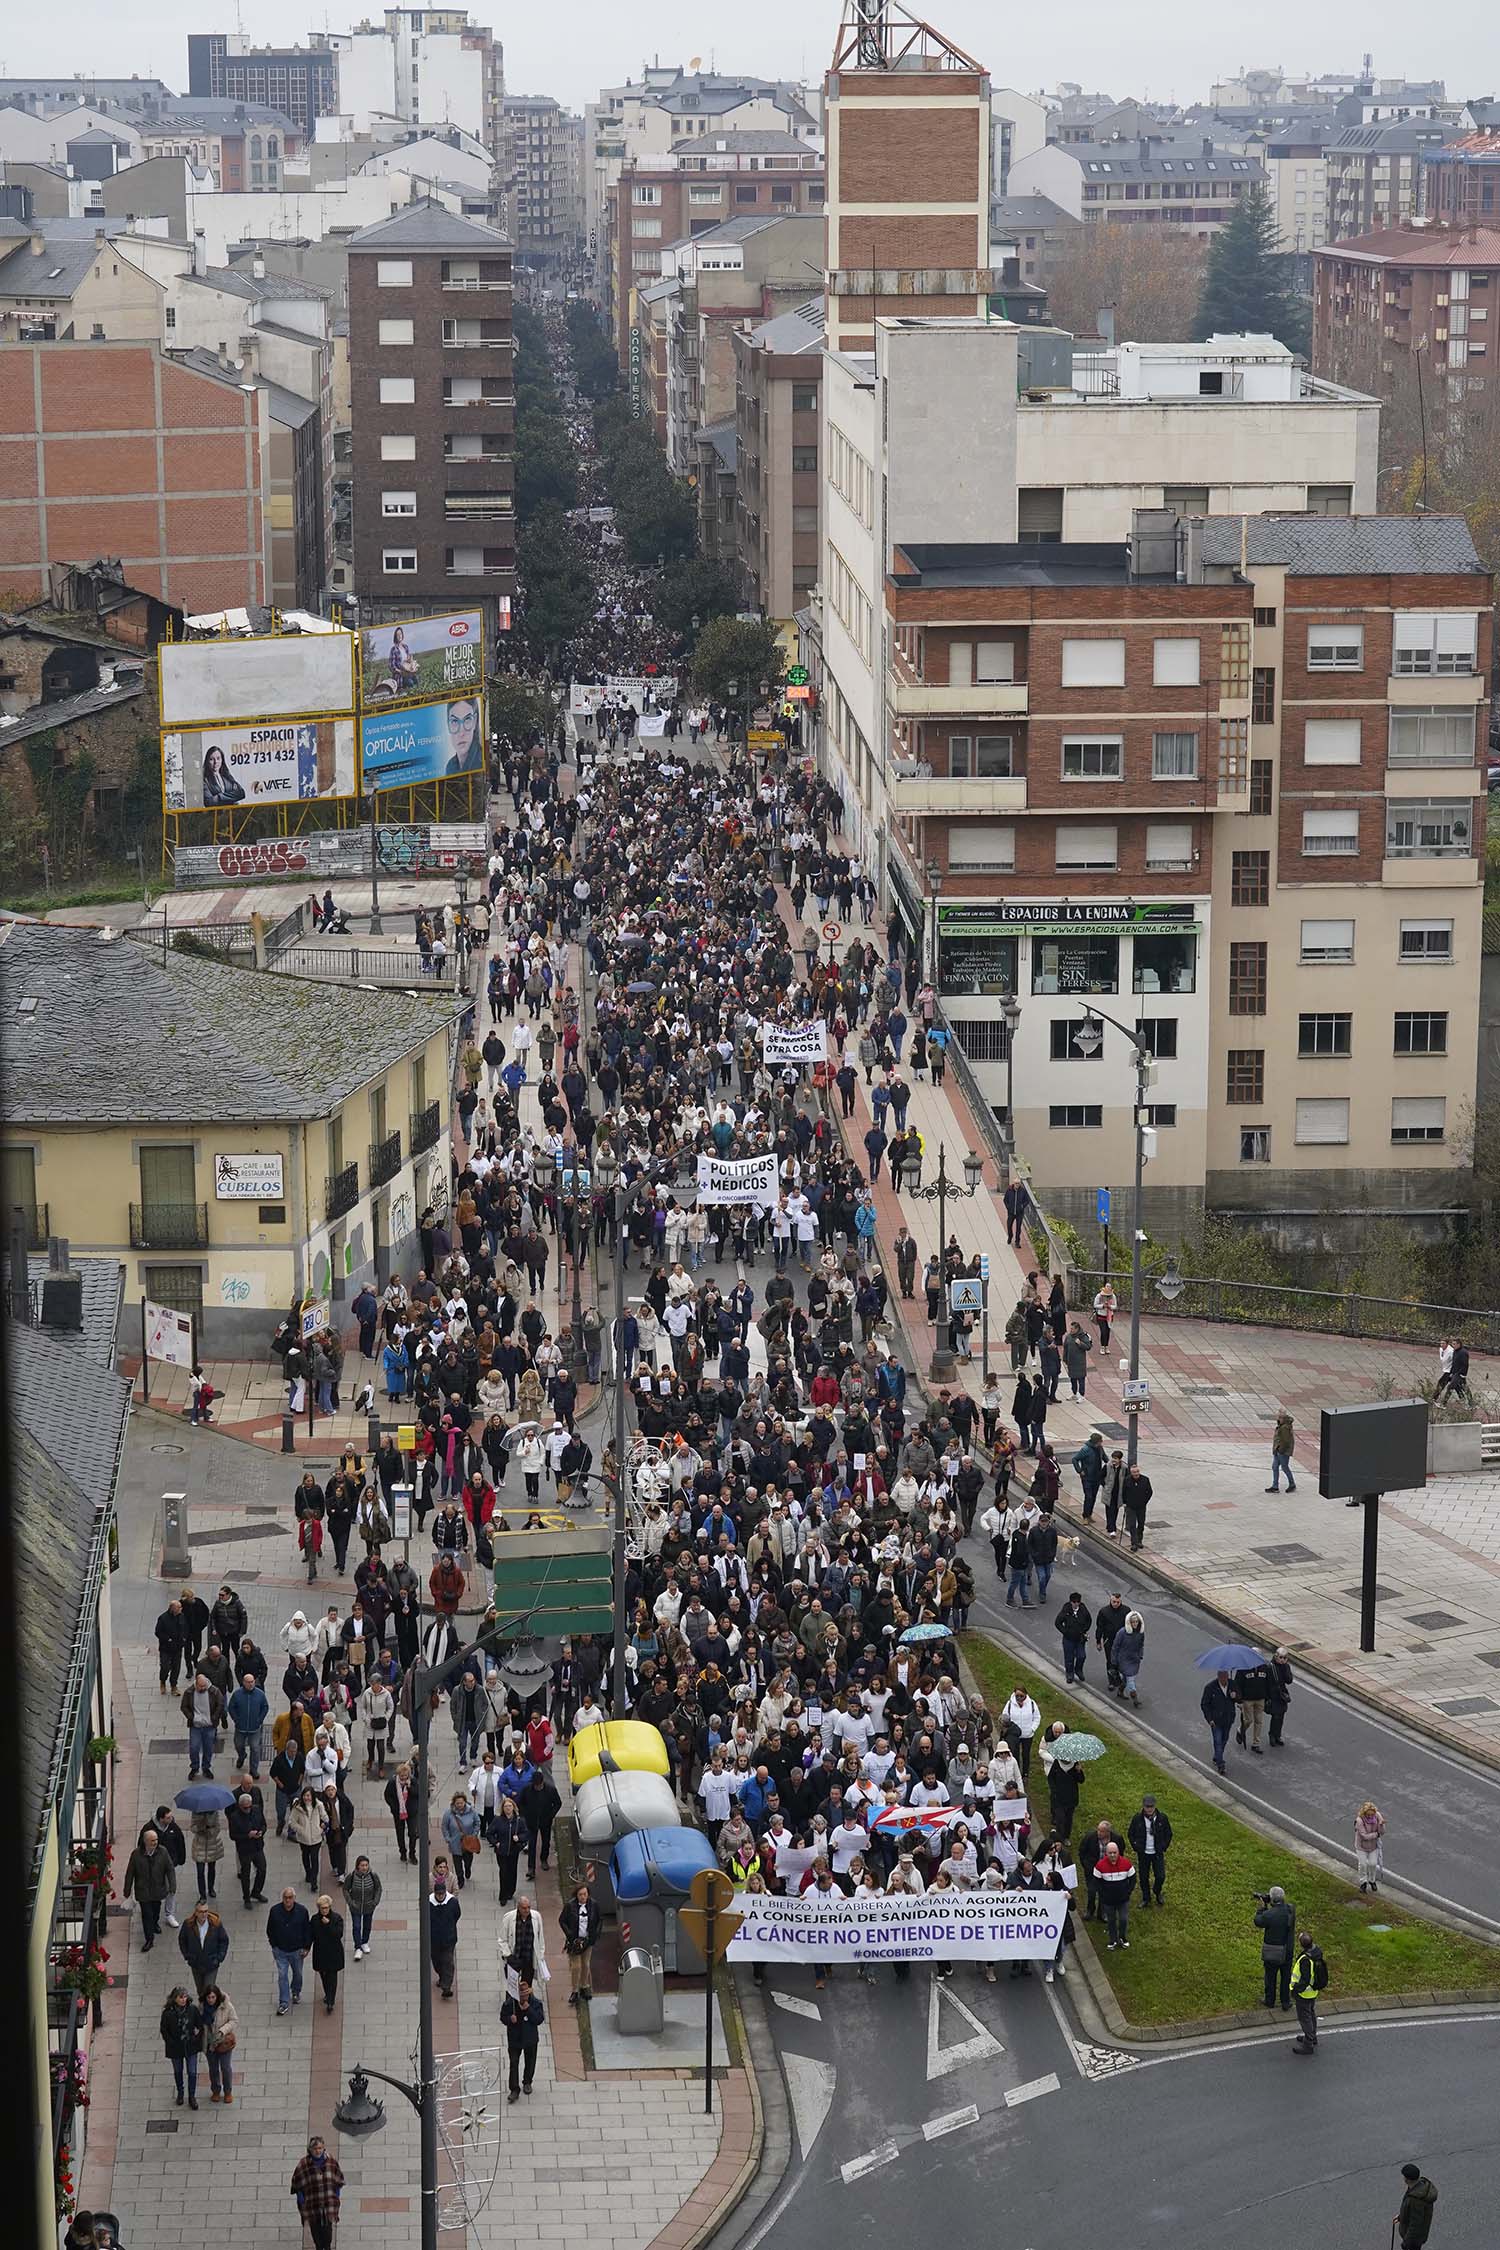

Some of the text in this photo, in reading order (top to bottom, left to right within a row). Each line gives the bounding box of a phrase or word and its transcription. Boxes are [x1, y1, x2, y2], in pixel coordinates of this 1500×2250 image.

[631, 328, 640, 419] ONDA BIERZO
[450, 623, 467, 634] ABRIL
[445, 643, 473, 667] MEJOR
[443, 660, 476, 683] MEJORES
[251, 728, 294, 743] ESPACIO
[231, 740, 294, 754] DISPONIBLE
[230, 749, 295, 765] 902 731 432
[264, 778, 292, 790] VAFE
[1002, 906, 1129, 920] ESPACIOS LA ENCINA
[1051, 925, 1178, 934] WWW.ESPACIOSLAENCINA.COM
[945, 972, 1009, 982] FINANCIACIÓN
[1062, 970, 1086, 981] SIN
[772, 1024, 815, 1035] TU SALUD
[769, 1033, 820, 1043] SE MERECE
[766, 1043, 821, 1053] OTRA COSA
[711, 1158, 774, 1176] POLÍTICOS
[218, 1182, 281, 1192] CUBELOS
[710, 1177, 768, 1191] MÉDICOS
[752, 1900, 765, 1908] EL
[768, 1901, 814, 1912] BIERZO,
[817, 1903, 832, 1911] LA
[836, 1902, 894, 1911] CABRERA
[895, 1900, 902, 1909] Y
[966, 1896, 1037, 1905] AGONIZAN
[763, 1911, 852, 1924] CONSEJERÍA
[858, 1913, 876, 1923] DE
[881, 1908, 950, 1922] SANIDAD
[954, 1908, 986, 1919] NOS
[990, 1907, 1049, 1918] IGNORA
[732, 1924, 1058, 1944] EL CÁNCER NO ENTIENDE DE TIEMPO
[853, 1946, 933, 1959] #ONCOBIERZO
